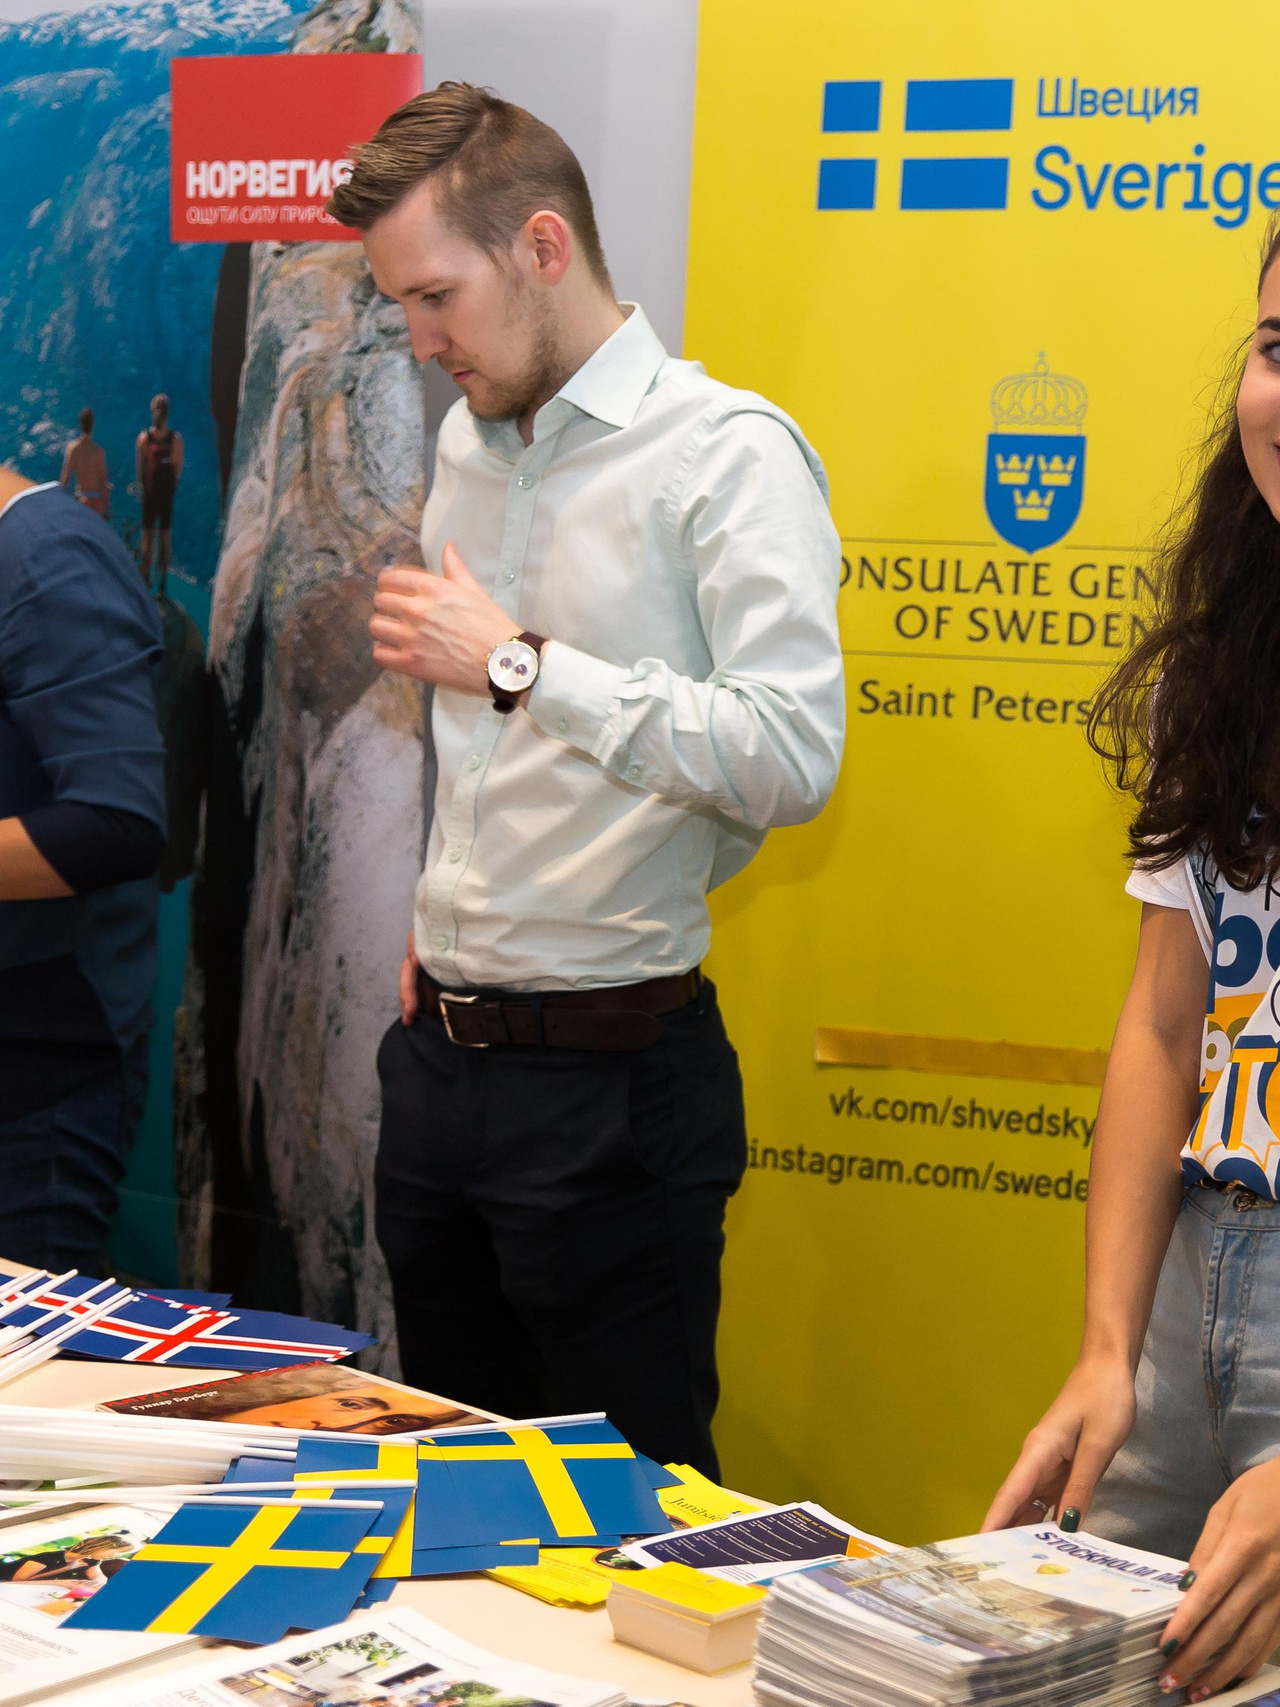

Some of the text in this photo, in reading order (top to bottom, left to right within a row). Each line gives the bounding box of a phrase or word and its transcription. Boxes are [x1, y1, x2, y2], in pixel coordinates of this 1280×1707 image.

[1036, 76, 1200, 125] Швеция
[186, 158, 355, 198] НОРВЕГИЯ
[894, 604, 954, 640] OF
[858, 679, 957, 719] Saint
[1035, 1531, 1160, 1578] STOCKHOLM
